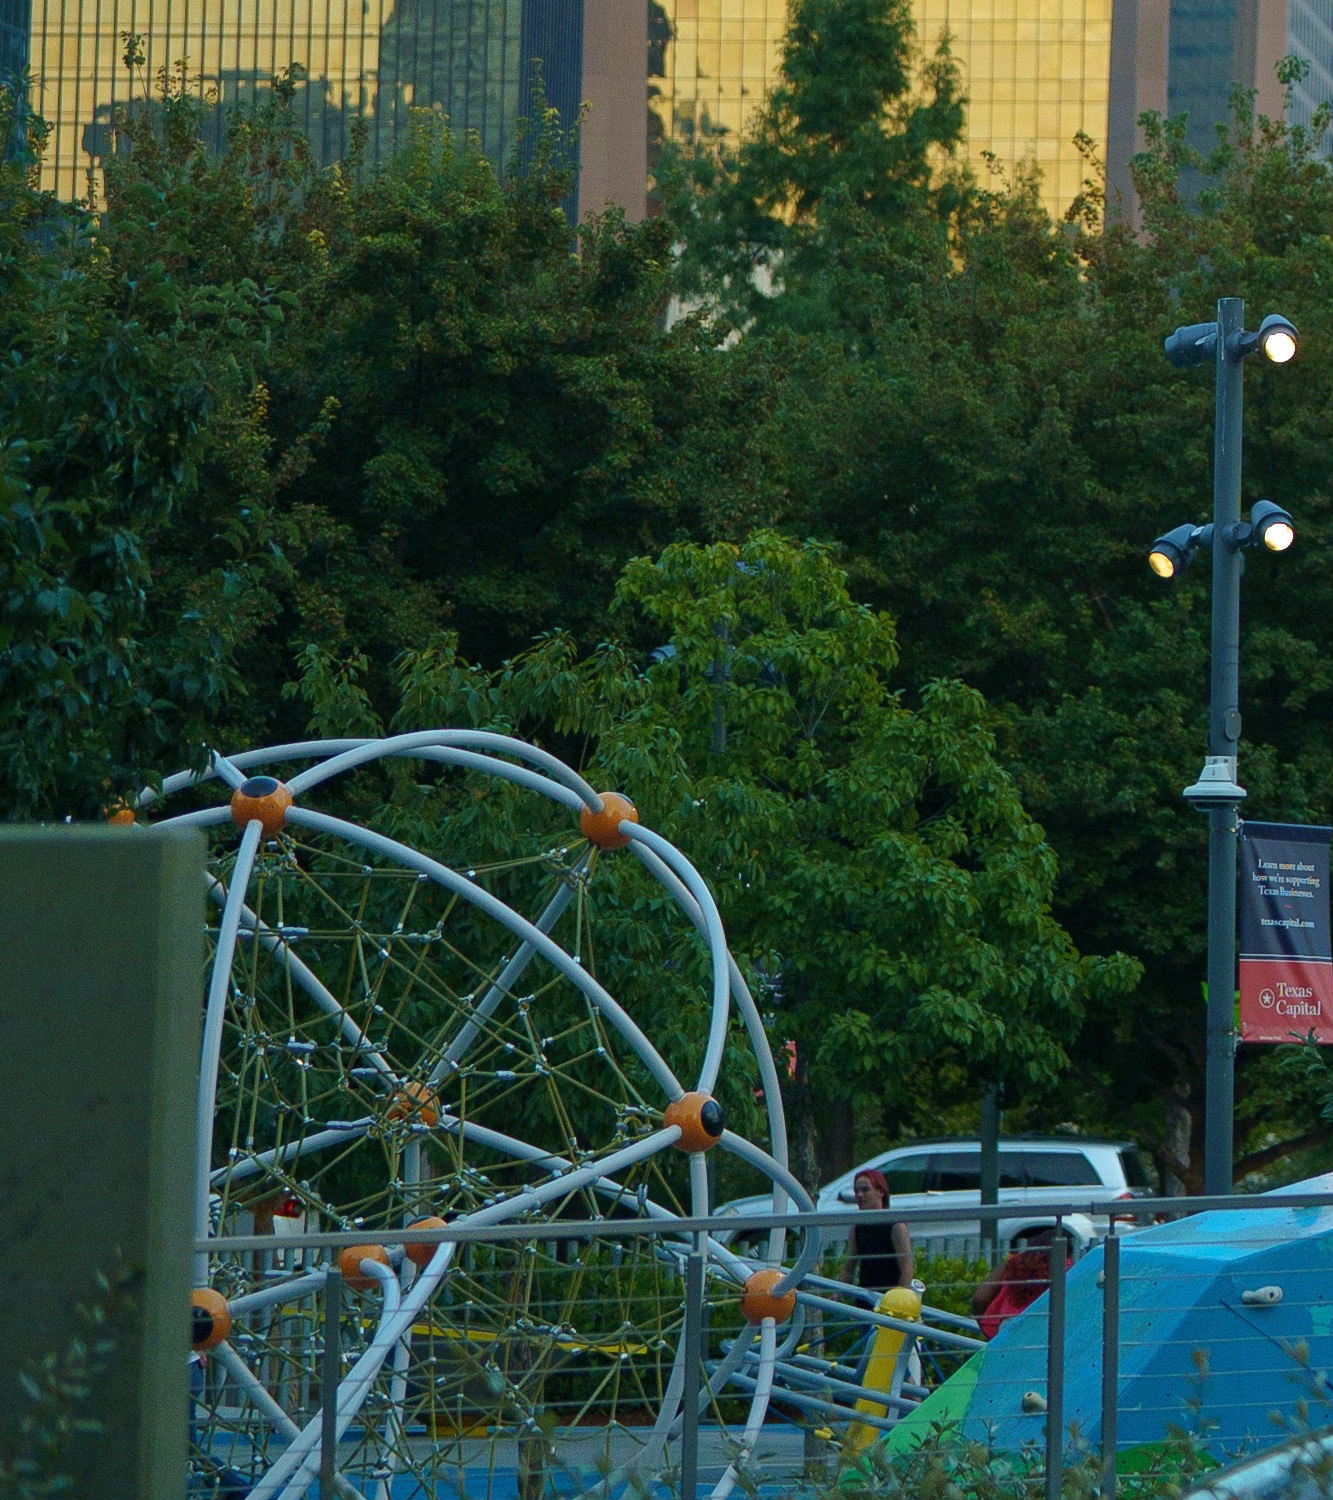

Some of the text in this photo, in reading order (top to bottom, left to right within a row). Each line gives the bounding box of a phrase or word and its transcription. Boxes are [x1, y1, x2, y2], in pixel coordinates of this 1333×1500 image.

[1258, 858, 1315, 872] Learn more about
[1252, 871, 1267, 882] how
[1286, 875, 1321, 889] supporting
[1257, 884, 1279, 896] Texas
[1261, 918, 1316, 929] texascapital.com
[1276, 982, 1314, 998] Texas
[1276, 999, 1322, 1019] Capital
